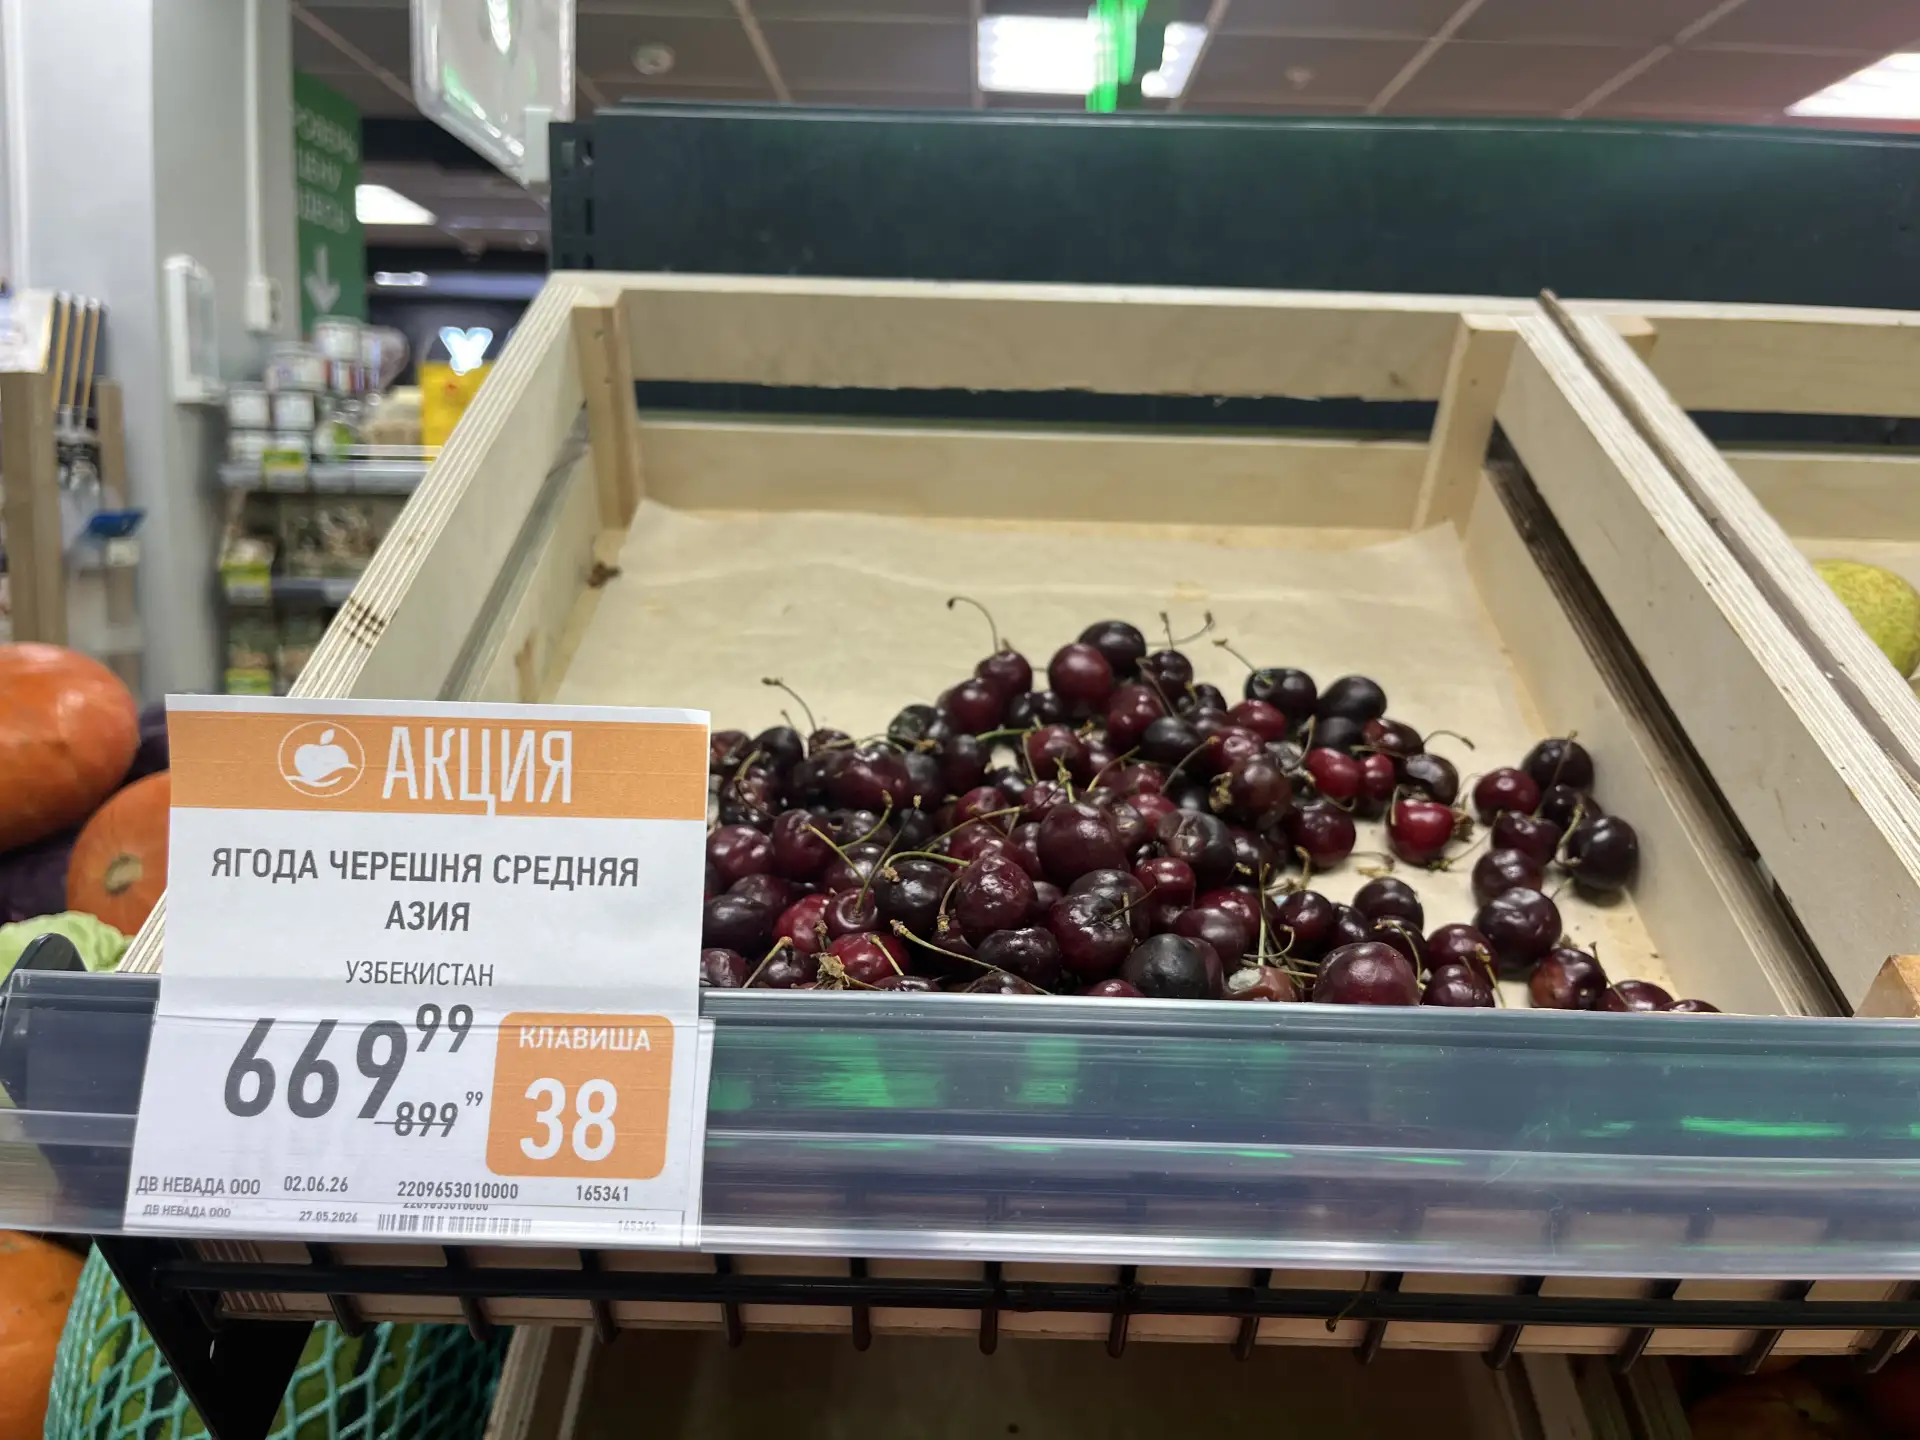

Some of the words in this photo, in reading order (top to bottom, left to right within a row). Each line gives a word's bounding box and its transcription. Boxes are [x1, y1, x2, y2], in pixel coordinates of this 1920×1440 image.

[382, 727, 573, 817] АКЦИЯ
[211, 847, 319, 884] ЯГОДА
[329, 850, 482, 883] ЧЕРЕШНЯ
[492, 854, 639, 891] СРЕДНЯЯ
[384, 900, 470, 932] АЗИЯ
[345, 959, 494, 987] УЗБЕКИСТАН
[519, 1027, 652, 1051] КЛАВИША
[224, 1017, 408, 1119] 669
[416, 1003, 474, 1053] 99
[394, 1101, 459, 1138] 899
[465, 1091, 484, 1107] 99
[519, 1077, 618, 1162] 38
[136, 1175, 159, 1195] ДВ
[162, 1177, 225, 1196] НЕВАДА
[283, 1175, 349, 1193] 02.06.26
[397, 1180, 519, 1199] 2209653010000
[576, 1184, 629, 1202] 165341
[142, 1204, 160, 1216] ДВ
[161, 1205, 206, 1218] НЕВАДА
[298, 1210, 359, 1223] 27.05.2026
